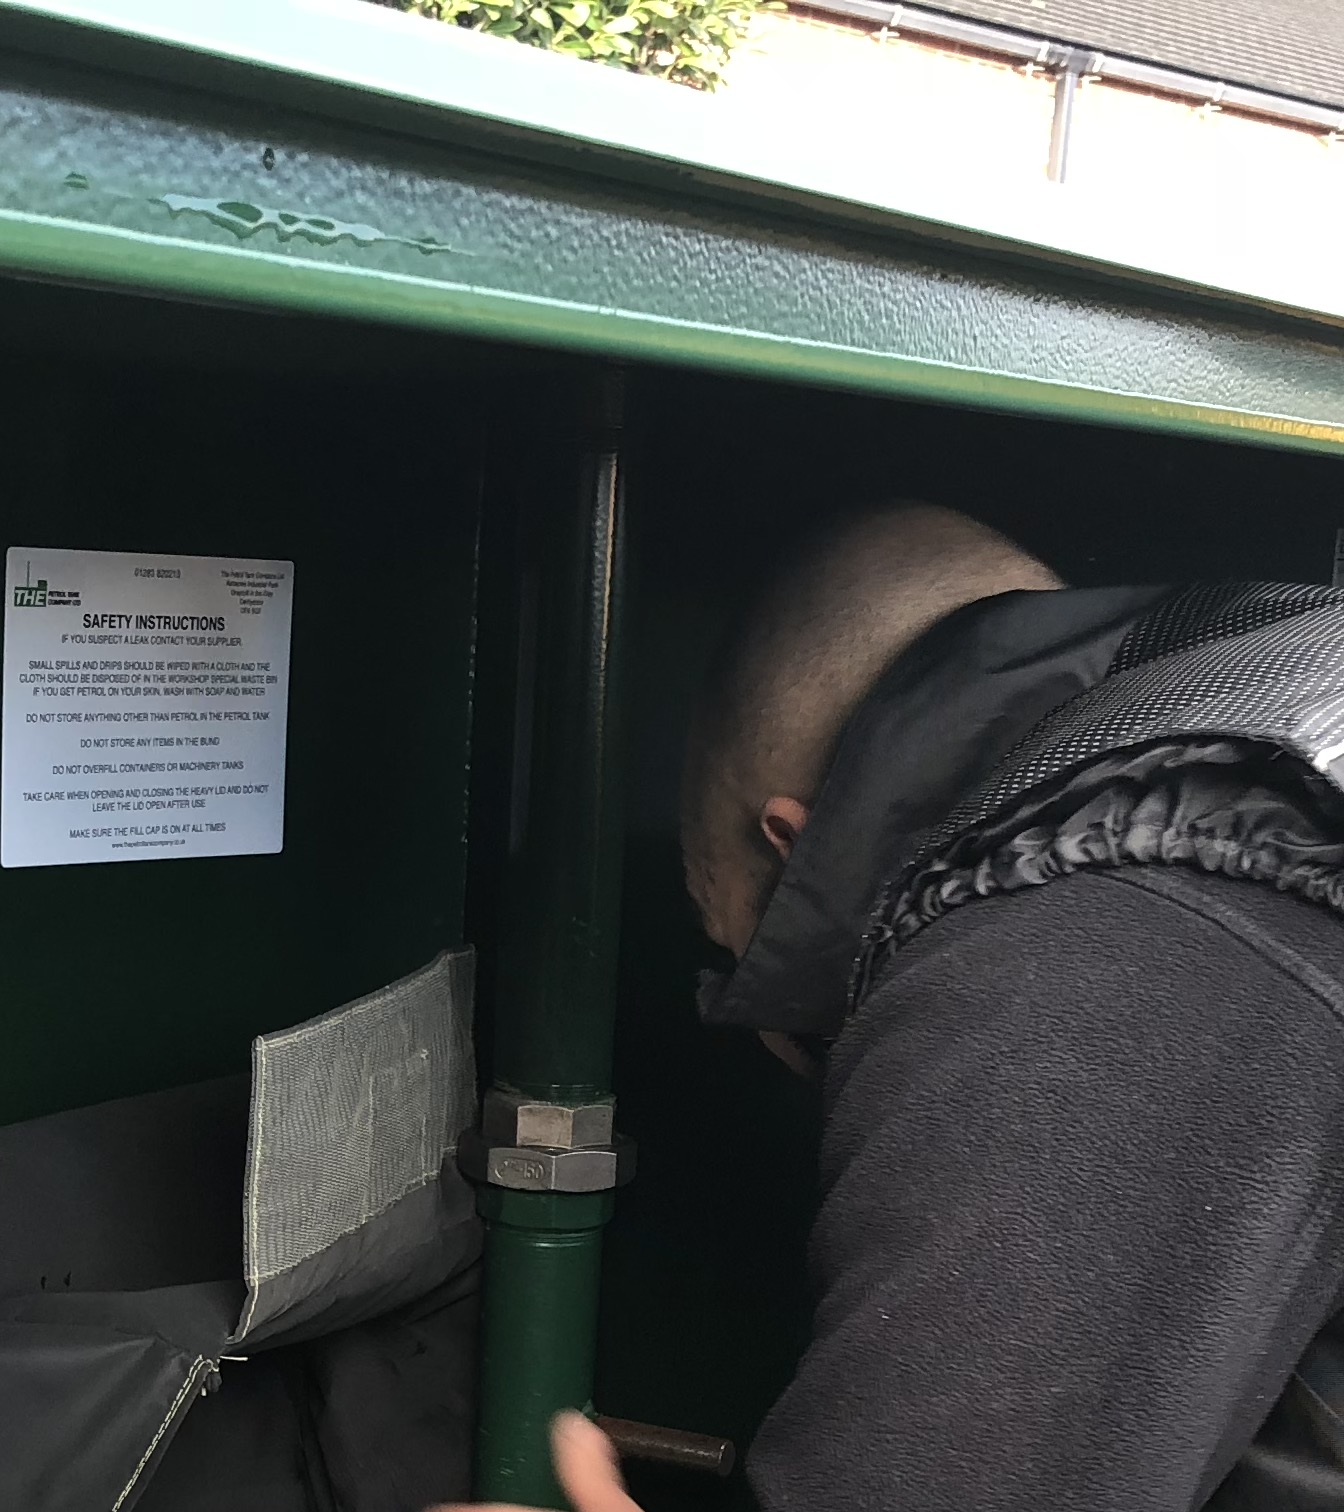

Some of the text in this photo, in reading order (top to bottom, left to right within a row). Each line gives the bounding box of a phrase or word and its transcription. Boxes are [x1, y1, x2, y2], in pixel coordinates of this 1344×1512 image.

[15, 590, 46, 605] THE
[83, 614, 225, 630] SAFETY INSTRUCTIONS
[62, 635, 69, 644] IF
[71, 635, 86, 644] YOU
[88, 635, 122, 644] SUSPECT
[130, 635, 149, 645] LEAK
[151, 636, 184, 645] CONTACT
[186, 636, 206, 645] YOUR
[29, 661, 54, 670] SMALL
[56, 661, 81, 670] SPILLS
[83, 661, 98, 670] AND
[100, 661, 122, 670] DRIPS
[124, 661, 154, 671] SHOULD
[156, 662, 165, 671] BE
[167, 662, 190, 671] WIPED
[192, 662, 210, 671] WITH
[216, 662, 240, 671] CLOTH
[241, 662, 256, 672] AND
[257, 662, 270, 672] THE
[20, 674, 277, 684] CLOTH SHOULD BE DISPOSED OF IN THE WORKSHOP SPECIAL WASTE BIN
[33, 687, 40, 696] IF
[42, 687, 58, 696] YOU
[60, 687, 75, 696] GET
[77, 687, 106, 696] PETROL
[108, 687, 119, 696] ON
[121, 687, 142, 696] YOUR
[164, 687, 185, 696] WASH
[186, 687, 204, 696] WITH
[206, 687, 225, 696] SOAP
[226, 687, 240, 696] AND
[242, 687, 265, 696] WATER
[26, 712, 271, 722] DO NOT STORE ANYTHING OTHER THAN PETROL IN THE PETROL TANK
[81, 737, 220, 747] DO NOT STORE ANY ITEMS IN THE BUND
[53, 761, 244, 774] DO NOT OVERFILL CONTAINERS OR MACHINERY TANKS
[23, 785, 269, 801] TAKE CARE WHEN OPENING AND CLOSING THE HEAVY LID AND DO NOT
[93, 799, 206, 812] LEAVE THE LID OPEN AFTER USE
[70, 824, 226, 838] MAKE SURE THE FILL CAP IS ON AT ALL TIMES
